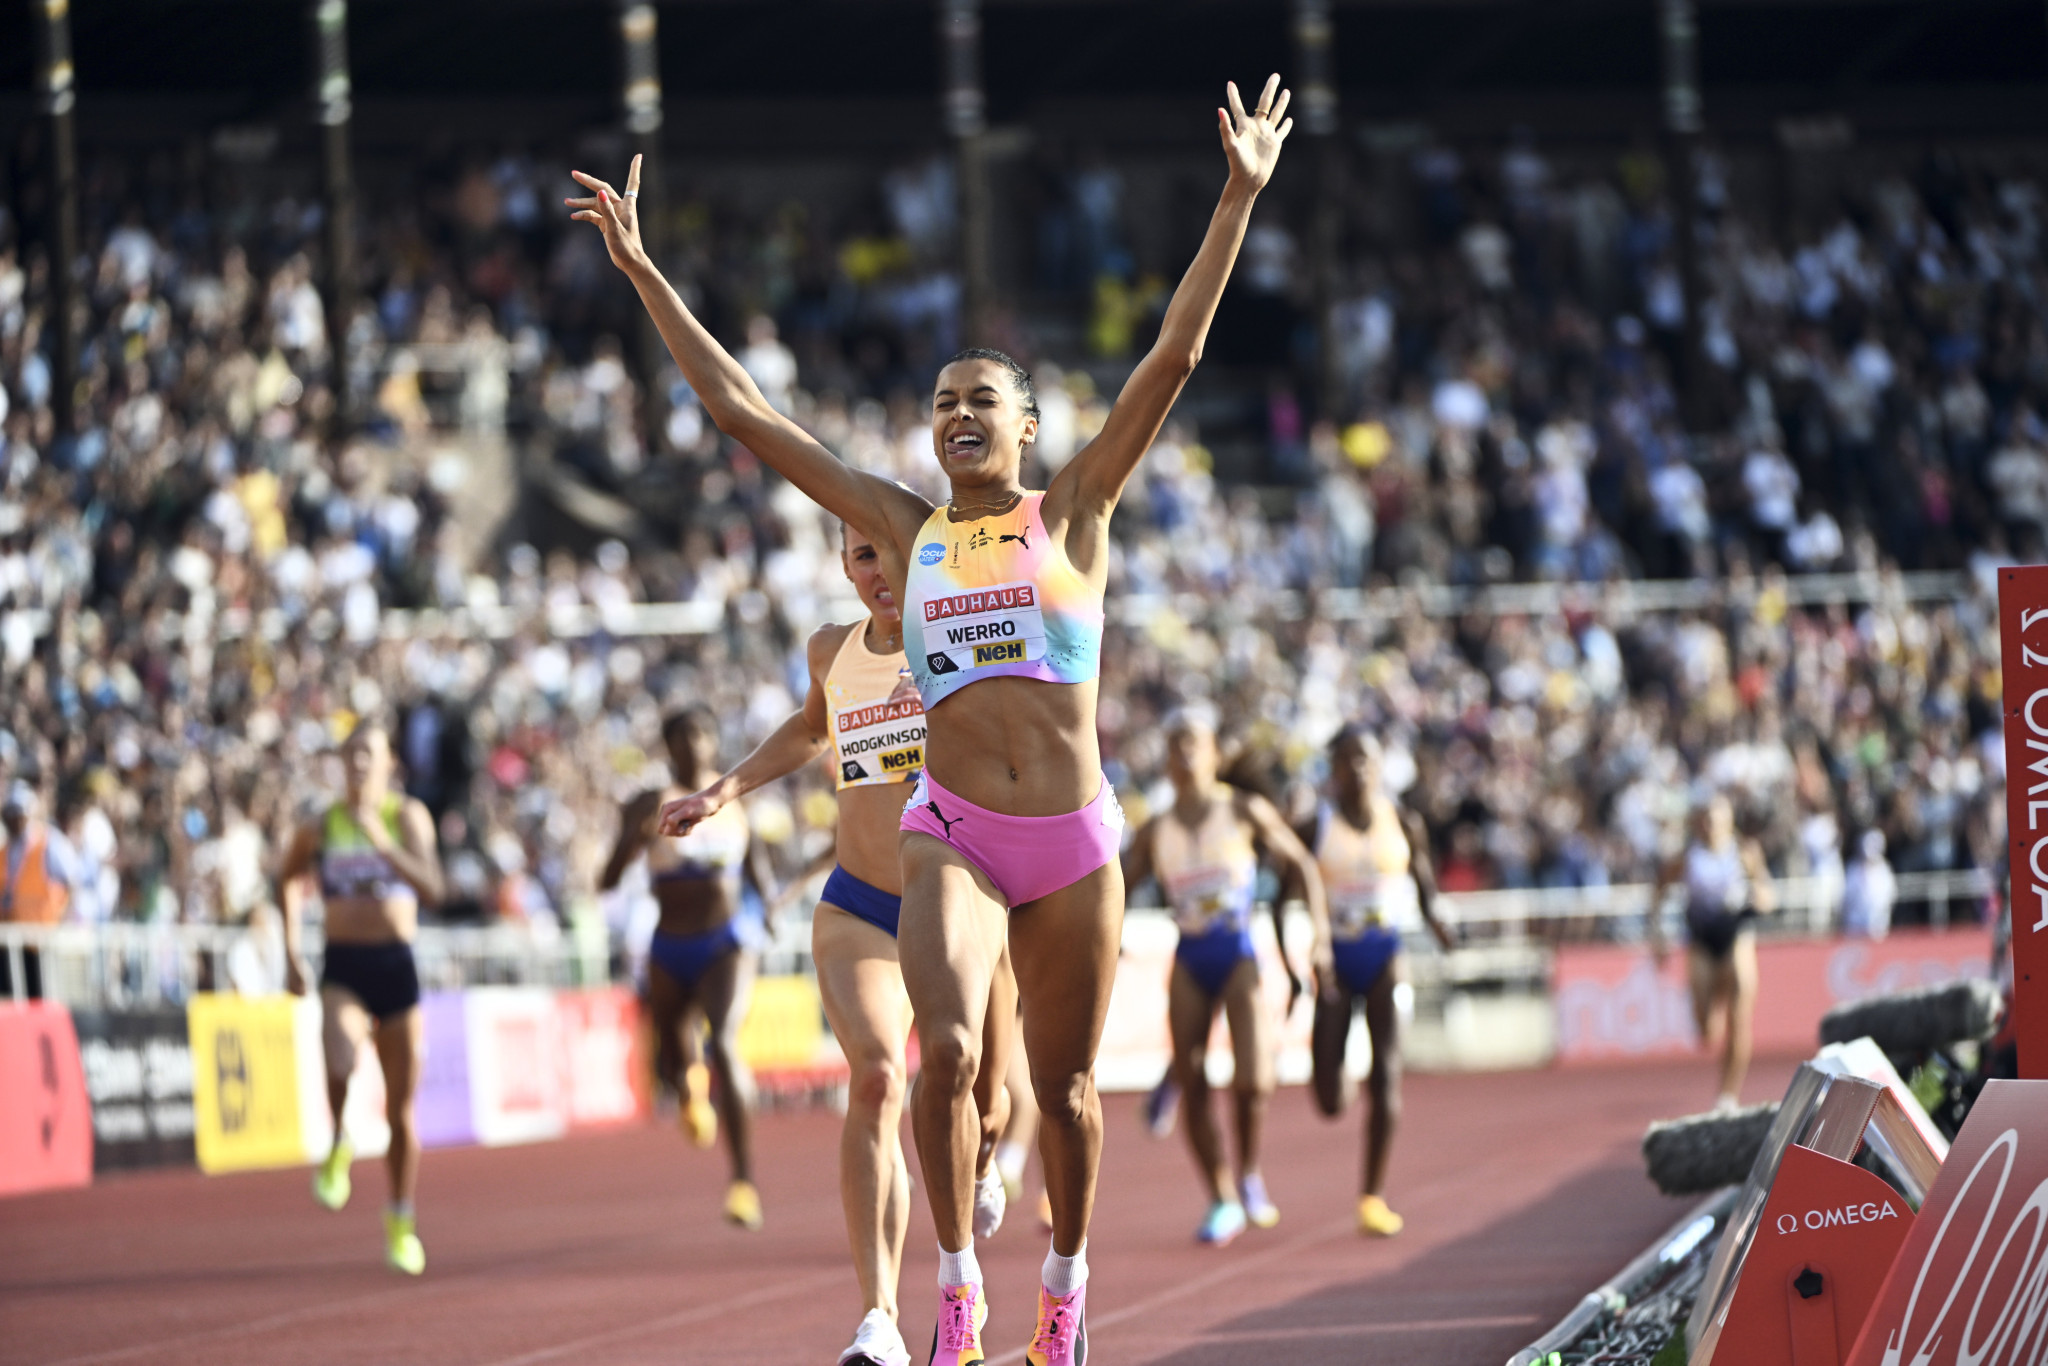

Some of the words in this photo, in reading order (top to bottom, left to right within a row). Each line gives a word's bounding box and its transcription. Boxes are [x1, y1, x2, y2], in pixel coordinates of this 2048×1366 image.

[918, 550, 947, 558] FOCUS
[925, 587, 1033, 620] BAUHAUS
[946, 620, 1016, 645] WERRO
[1804, 1199, 1899, 1230] OMEGA
